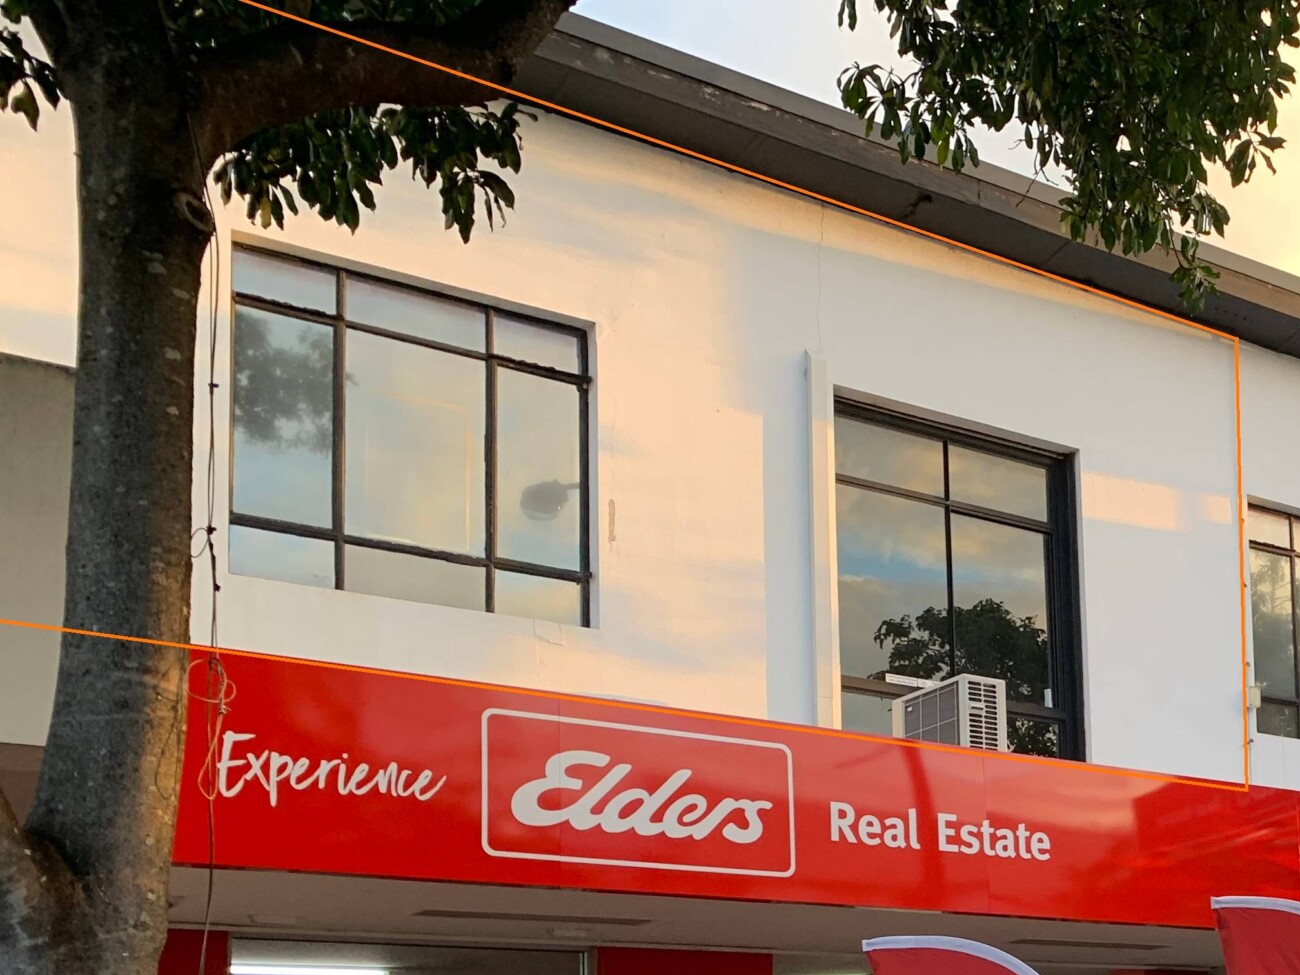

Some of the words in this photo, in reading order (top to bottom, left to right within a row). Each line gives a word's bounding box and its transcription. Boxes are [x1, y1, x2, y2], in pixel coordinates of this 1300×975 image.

[217, 731, 447, 808] Experience
[511, 749, 773, 845] Elders
[830, 802, 921, 851] Real
[937, 812, 1052, 862] Estate
